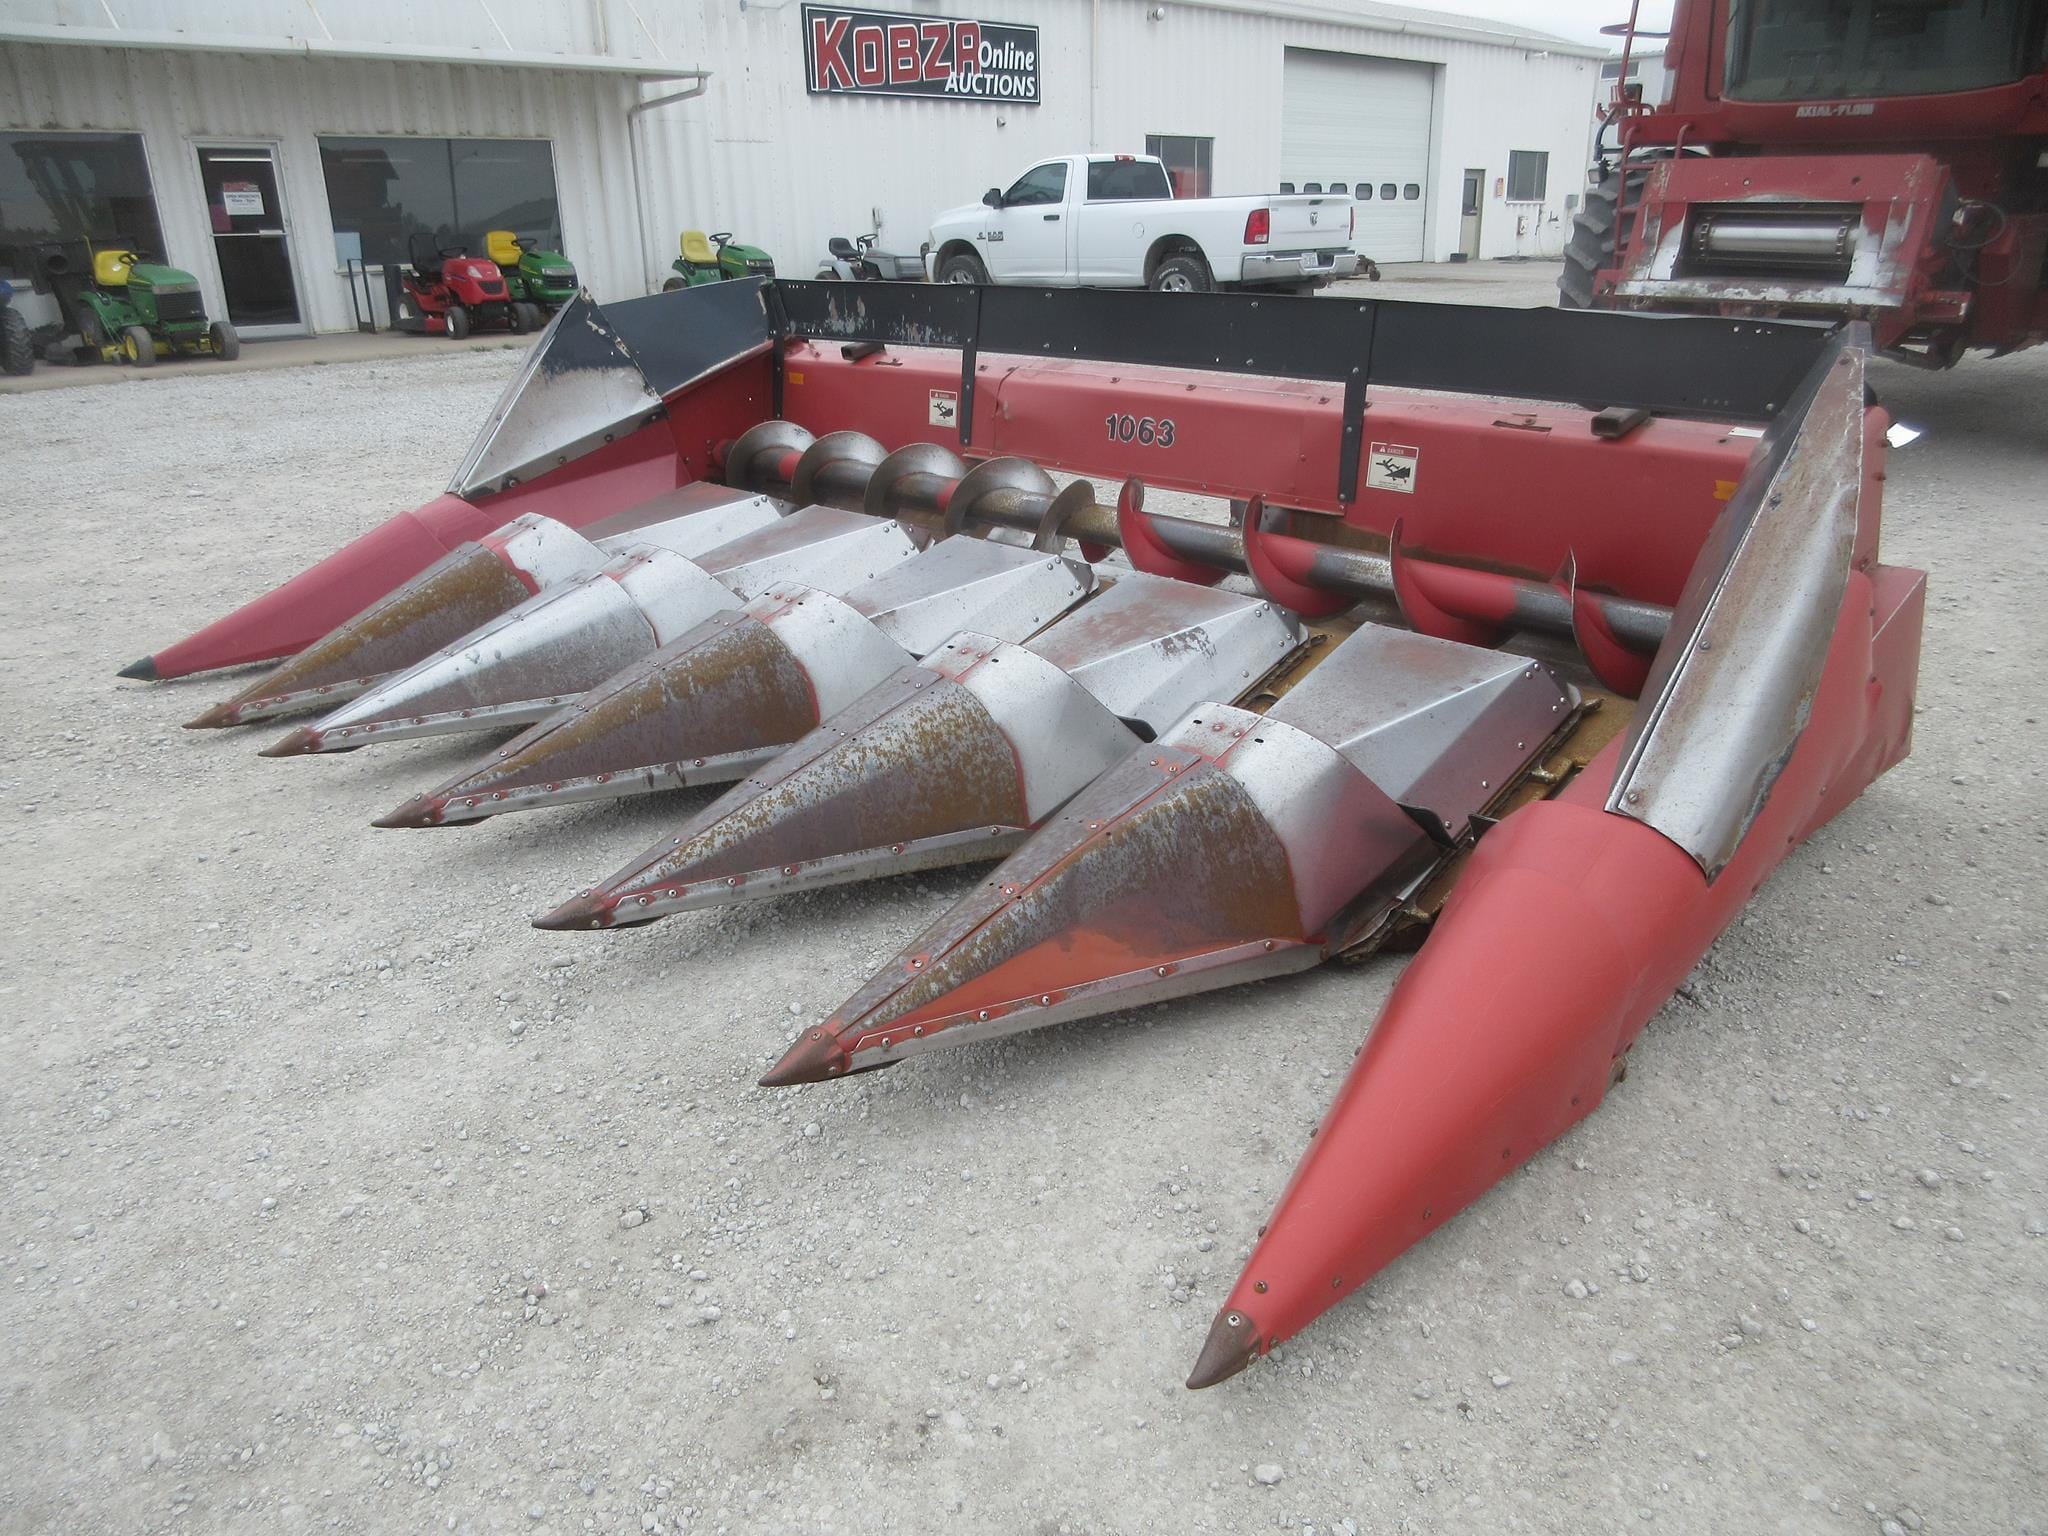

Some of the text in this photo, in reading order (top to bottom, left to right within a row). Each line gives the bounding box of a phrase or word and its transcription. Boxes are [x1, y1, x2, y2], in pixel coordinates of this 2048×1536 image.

[813, 16, 1034, 91] KOBZA Online
[945, 72, 1035, 97] AUCTIONS
[1105, 413, 1176, 448] 1063
